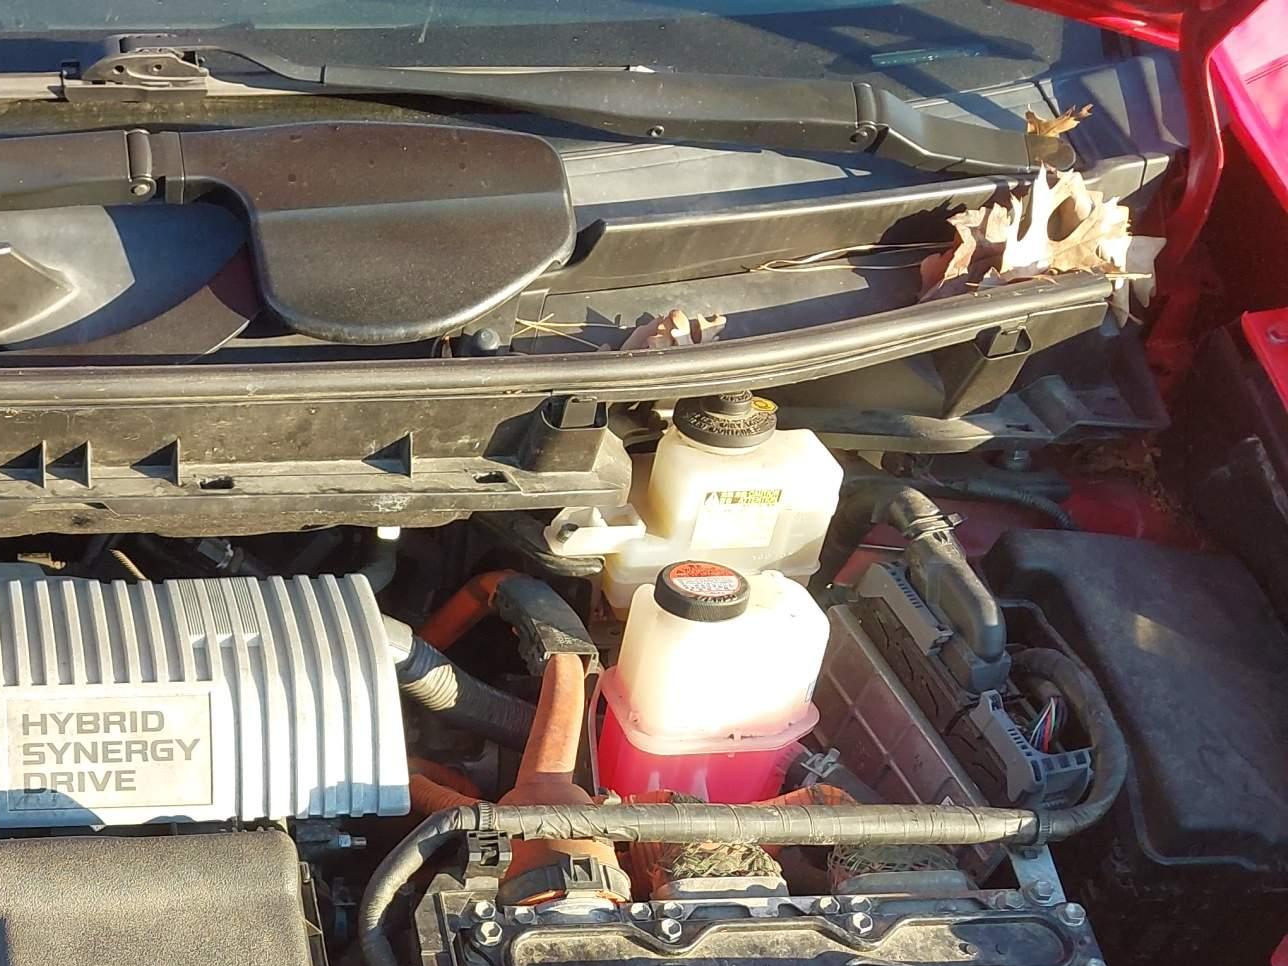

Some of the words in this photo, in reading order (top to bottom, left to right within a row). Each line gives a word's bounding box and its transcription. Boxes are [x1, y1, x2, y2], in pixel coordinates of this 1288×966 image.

[22, 711, 165, 735] HYBRID
[22, 738, 201, 766] SYNERGY
[23, 769, 136, 795] DRIVE
